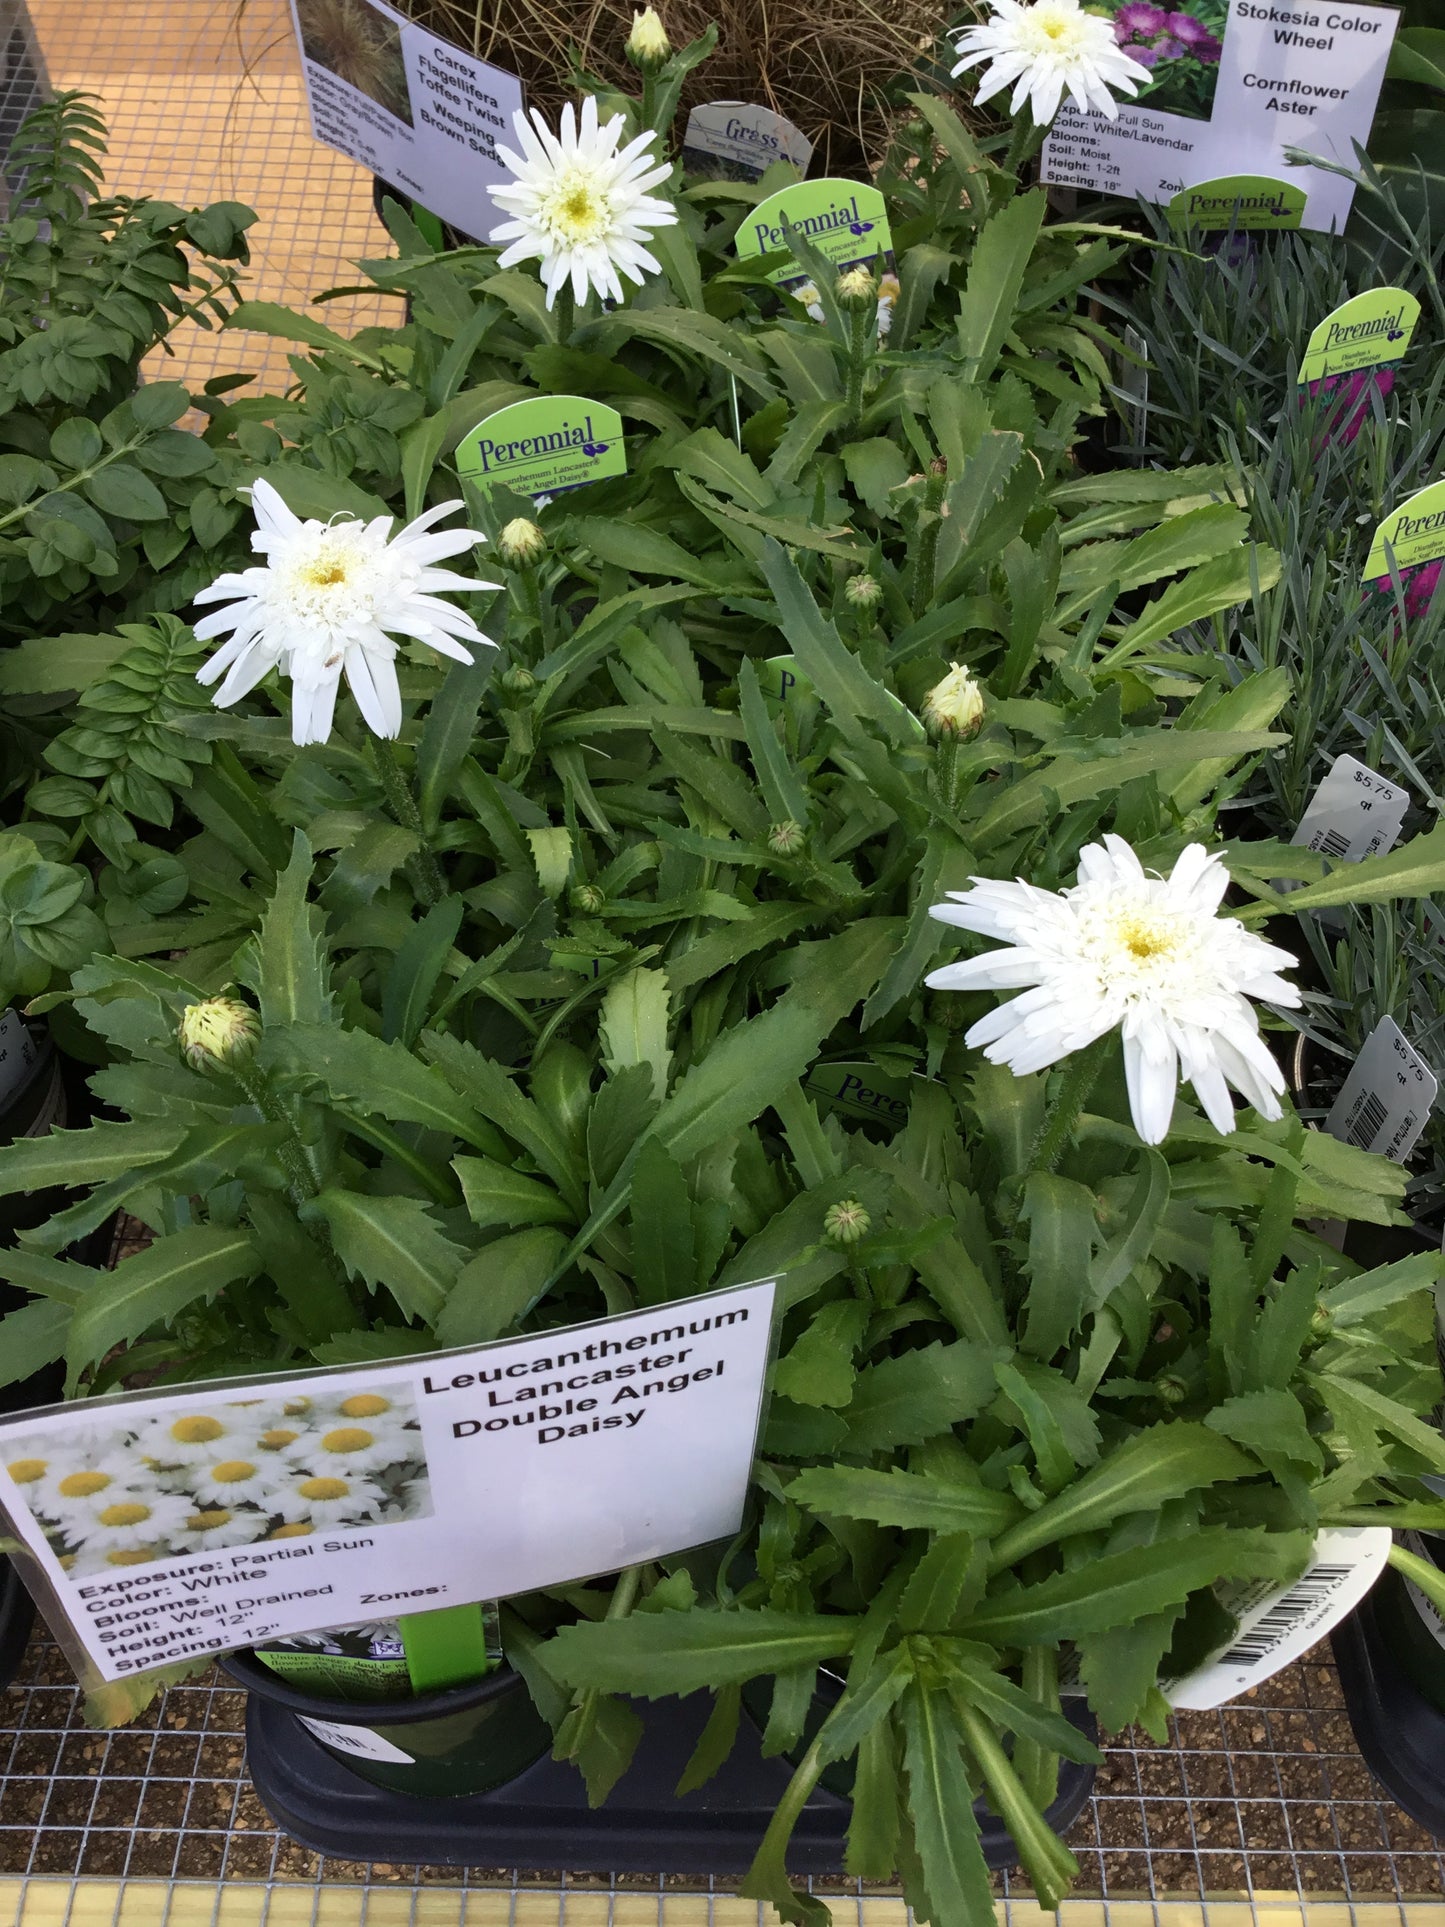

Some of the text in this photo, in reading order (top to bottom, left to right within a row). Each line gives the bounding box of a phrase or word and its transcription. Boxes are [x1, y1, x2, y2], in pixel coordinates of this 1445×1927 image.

[1236, 1, 1382, 34] Stokesia Color
[1273, 29, 1335, 51] Wheel
[433, 47, 477, 80] Carex
[308, 78, 338, 100] Color:
[418, 54, 498, 109] Flagellifera
[1242, 73, 1349, 100] Cornflower
[311, 90, 349, 119] Blooms:
[416, 69, 506, 129] Toffee Twist
[1264, 97, 1318, 116] Aster
[420, 108, 505, 168] Brown Sedg
[432, 100, 496, 147] Weeping
[1051, 130, 1101, 147] Blooms:
[1053, 116, 1195, 153] Color: White/Lavendar
[1117, 112, 1140, 127] Full
[1142, 118, 1165, 132] Sun
[1048, 143, 1112, 162] Soil: Moist
[1048, 157, 1121, 177] Height: 1-2ft
[1046, 170, 1122, 192] Spacing: 18"
[1158, 179, 1182, 193] Zon
[1322, 305, 1406, 351] Perennial
[478, 415, 596, 473] Perennial
[532, 478, 558, 492] Angel
[1353, 770, 1395, 801] $5.75
[1360, 800, 1374, 811] qt
[1393, 1038, 1425, 1082] $5.75
[1397, 1072, 1407, 1086] qt
[423, 1307, 749, 1395] Leucanthemum
[487, 1347, 693, 1408] Lancaster
[452, 1359, 725, 1439] Double Angel
[537, 1408, 647, 1445] Daisy
[78, 1538, 374, 1600] Exposure: Partial Sun
[86, 1568, 268, 1614] Color: White
[360, 1583, 448, 1605] Zones:
[93, 1594, 210, 1629] Blooms:
[98, 1584, 334, 1644] Soil: Well Drained
[1305, 1601, 1336, 1631] QUART
[106, 1610, 254, 1658] Height: 12"
[115, 1622, 280, 1672] Spacing: 12"
